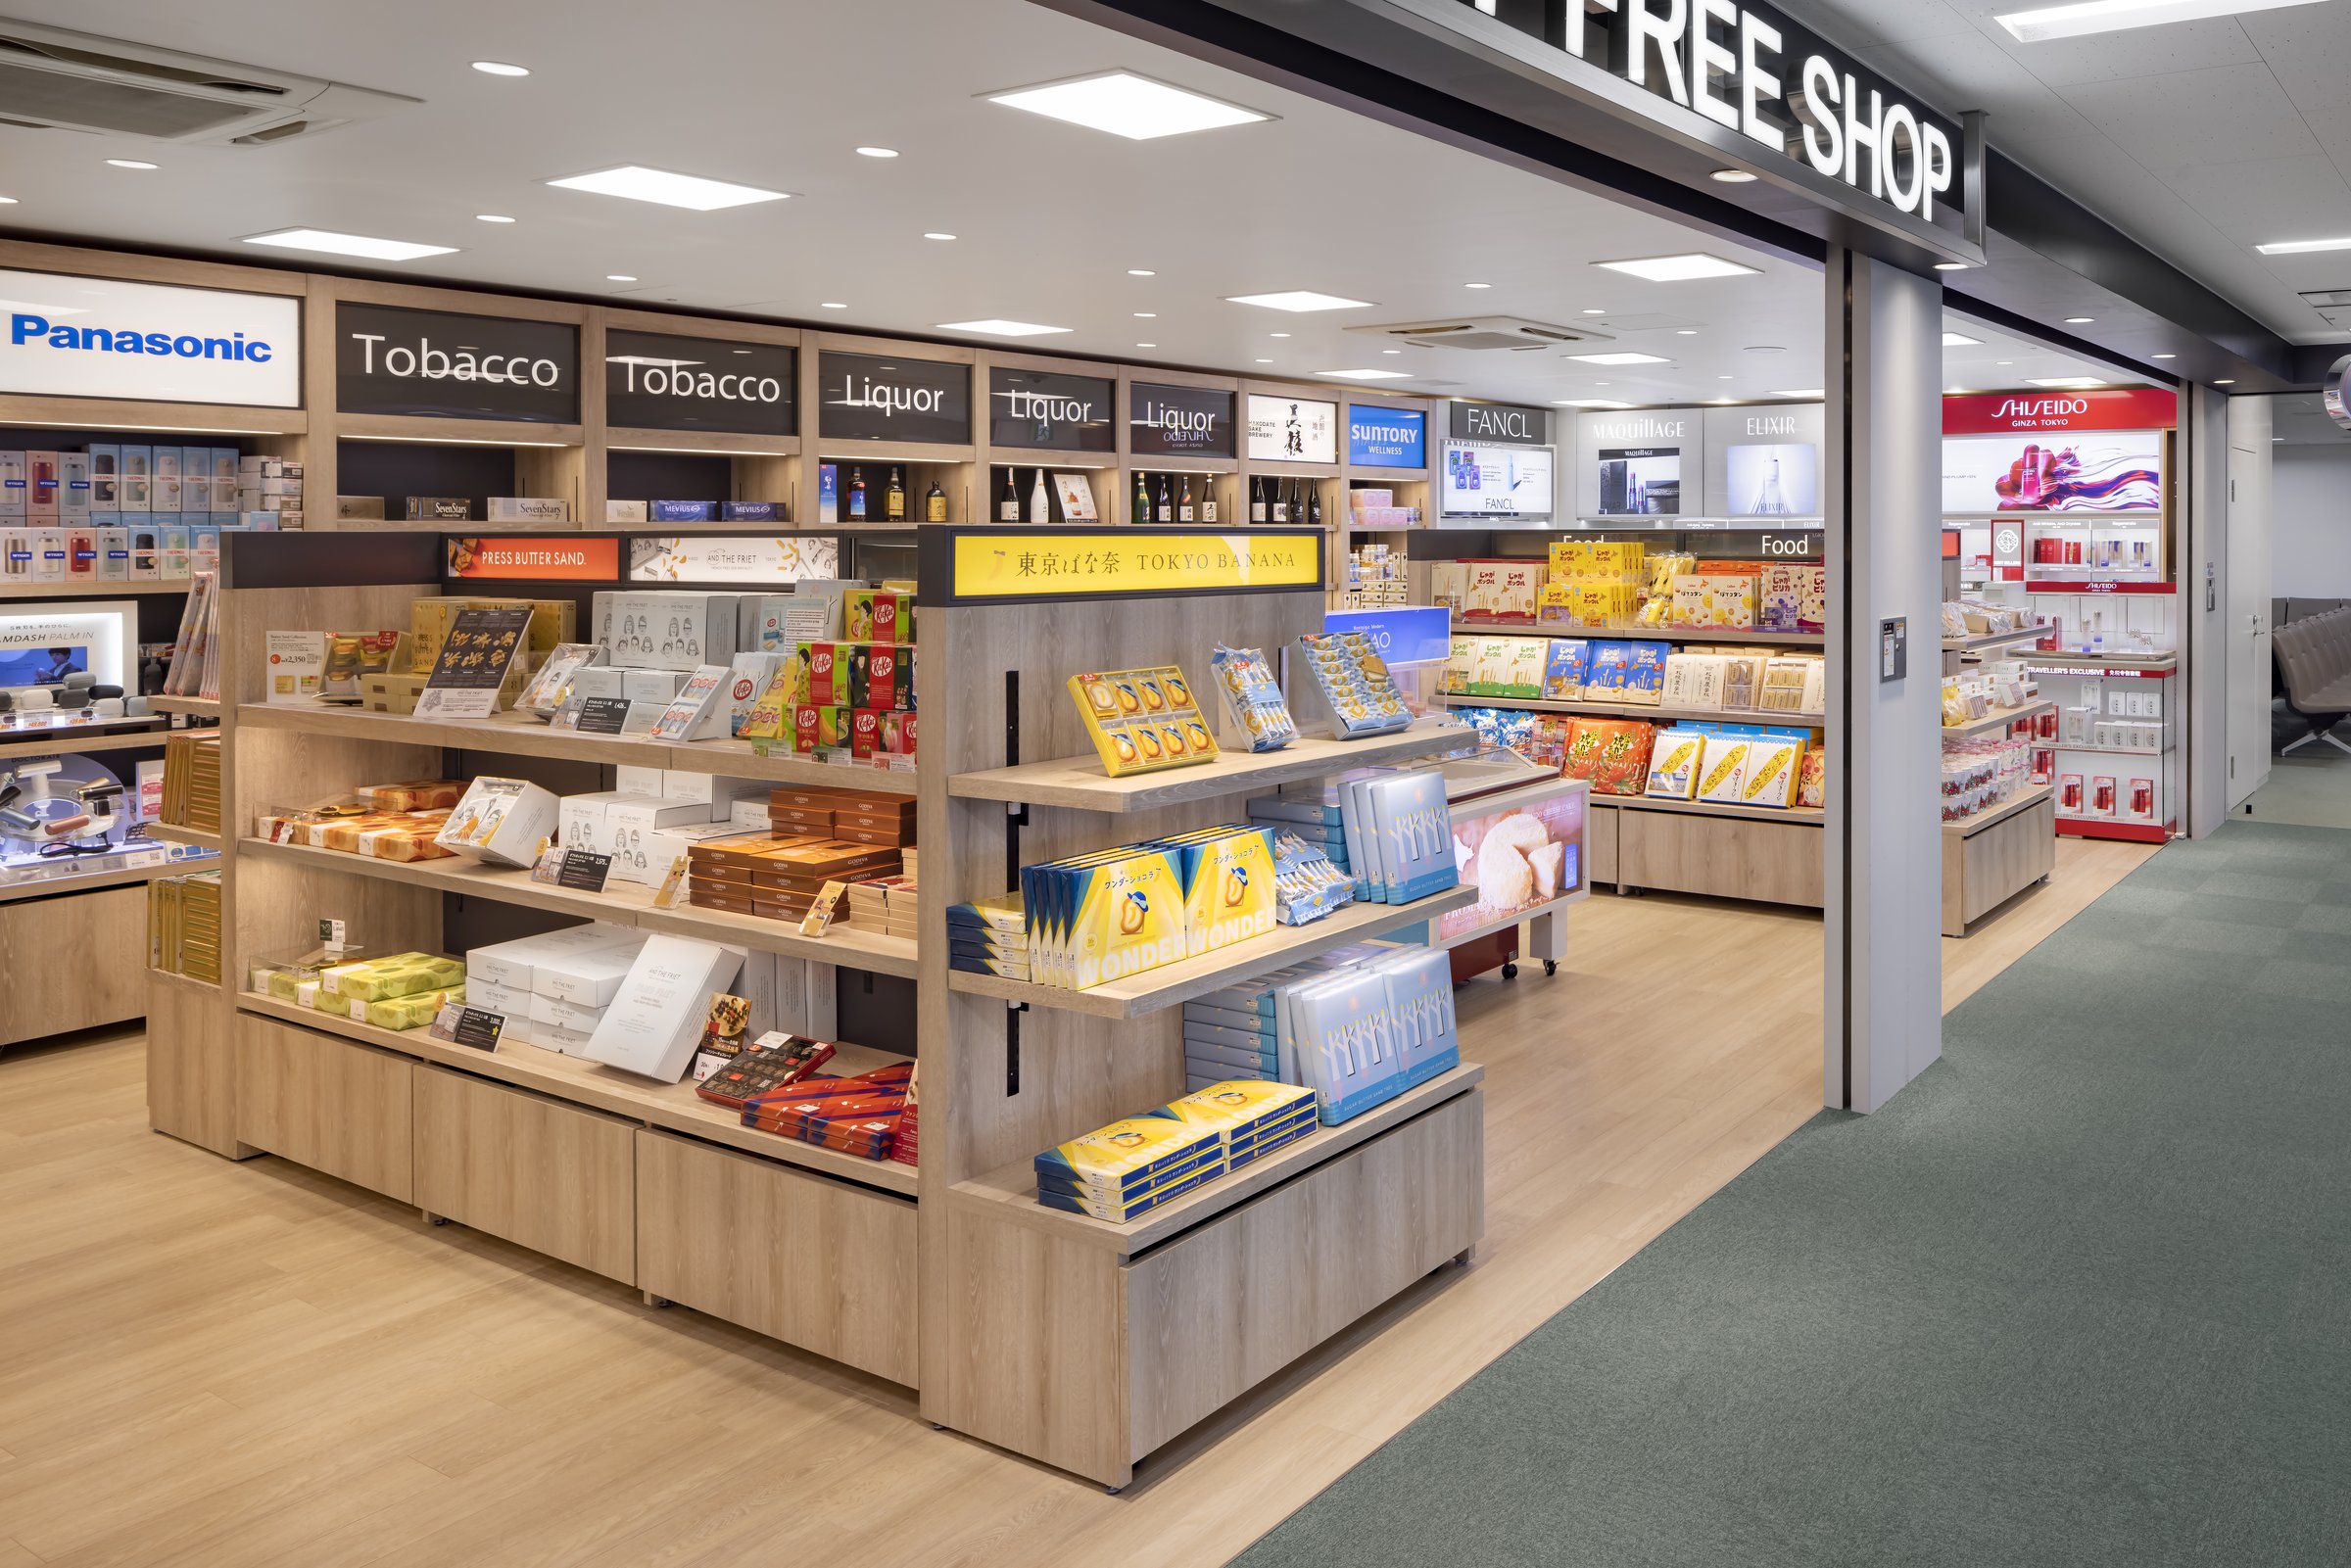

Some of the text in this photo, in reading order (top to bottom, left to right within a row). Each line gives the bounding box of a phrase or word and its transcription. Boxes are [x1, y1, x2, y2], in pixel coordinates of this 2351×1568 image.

[1803, 55, 1951, 221] SHOP
[11, 313, 272, 363] Panasonic
[353, 334, 559, 387] Tobacco
[625, 358, 781, 403] Tobacco
[846, 375, 944, 416] Liquor
[1012, 389, 1091, 426] Liquor
[1991, 399, 2087, 418] SHISEIDO
[1148, 402, 1215, 436] Liquor
[1468, 408, 1532, 438] FANCL
[1747, 416, 1796, 436] ELIXIR
[1351, 424, 1417, 444] SUNTORY
[1368, 446, 1402, 455] WELLNESS
[1485, 499, 1514, 509] FANCL
[1760, 502, 1784, 512] ELIXIR
[1762, 535, 1808, 555] Food
[482, 551, 585, 565] PRESS BUTTER SAND
[721, 554, 736, 563] THE
[738, 554, 756, 563] FRIET
[1017, 550, 1295, 577] 東京ばな奈 TOKYO BANANA
[874, 604, 894, 623] KitKat
[0, 634, 46, 642] MDASH
[49, 632, 79, 641] PALM
[812, 654, 833, 673] KitKat
[872, 656, 892, 677] KitKat
[735, 682, 752, 699] KitKat
[799, 710, 817, 727] KitKat
[857, 715, 876, 732] KitKat
[847, 857, 868, 866] GODIVA
[1213, 849, 1254, 865] ワンダーショコラ
[1104, 872, 1154, 889] ワンダーショコラ
